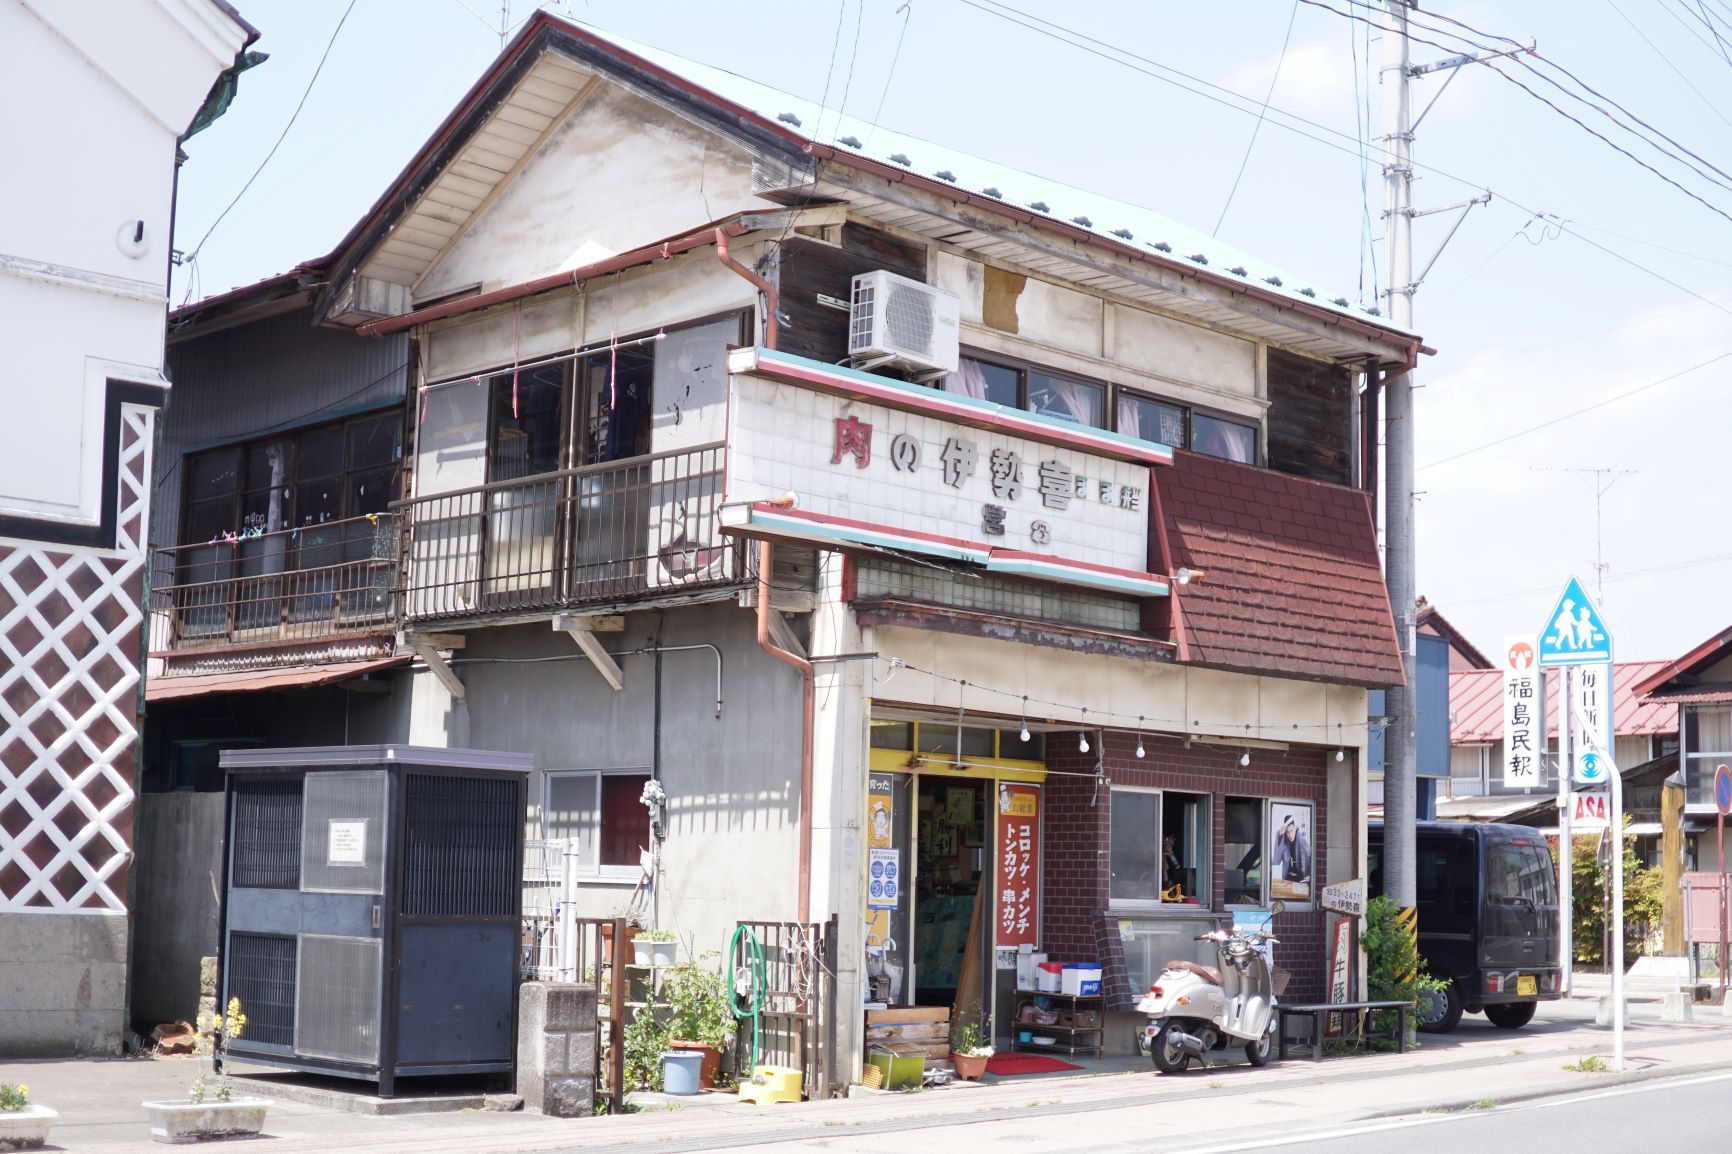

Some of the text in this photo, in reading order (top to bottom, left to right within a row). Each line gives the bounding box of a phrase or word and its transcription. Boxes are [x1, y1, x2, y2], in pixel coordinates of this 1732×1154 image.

[1508, 676, 1533, 778] 福島民報
[1002, 823, 1018, 934] トンカツ・串カツ
[1016, 824, 1031, 935] コロッケ・メンチ
